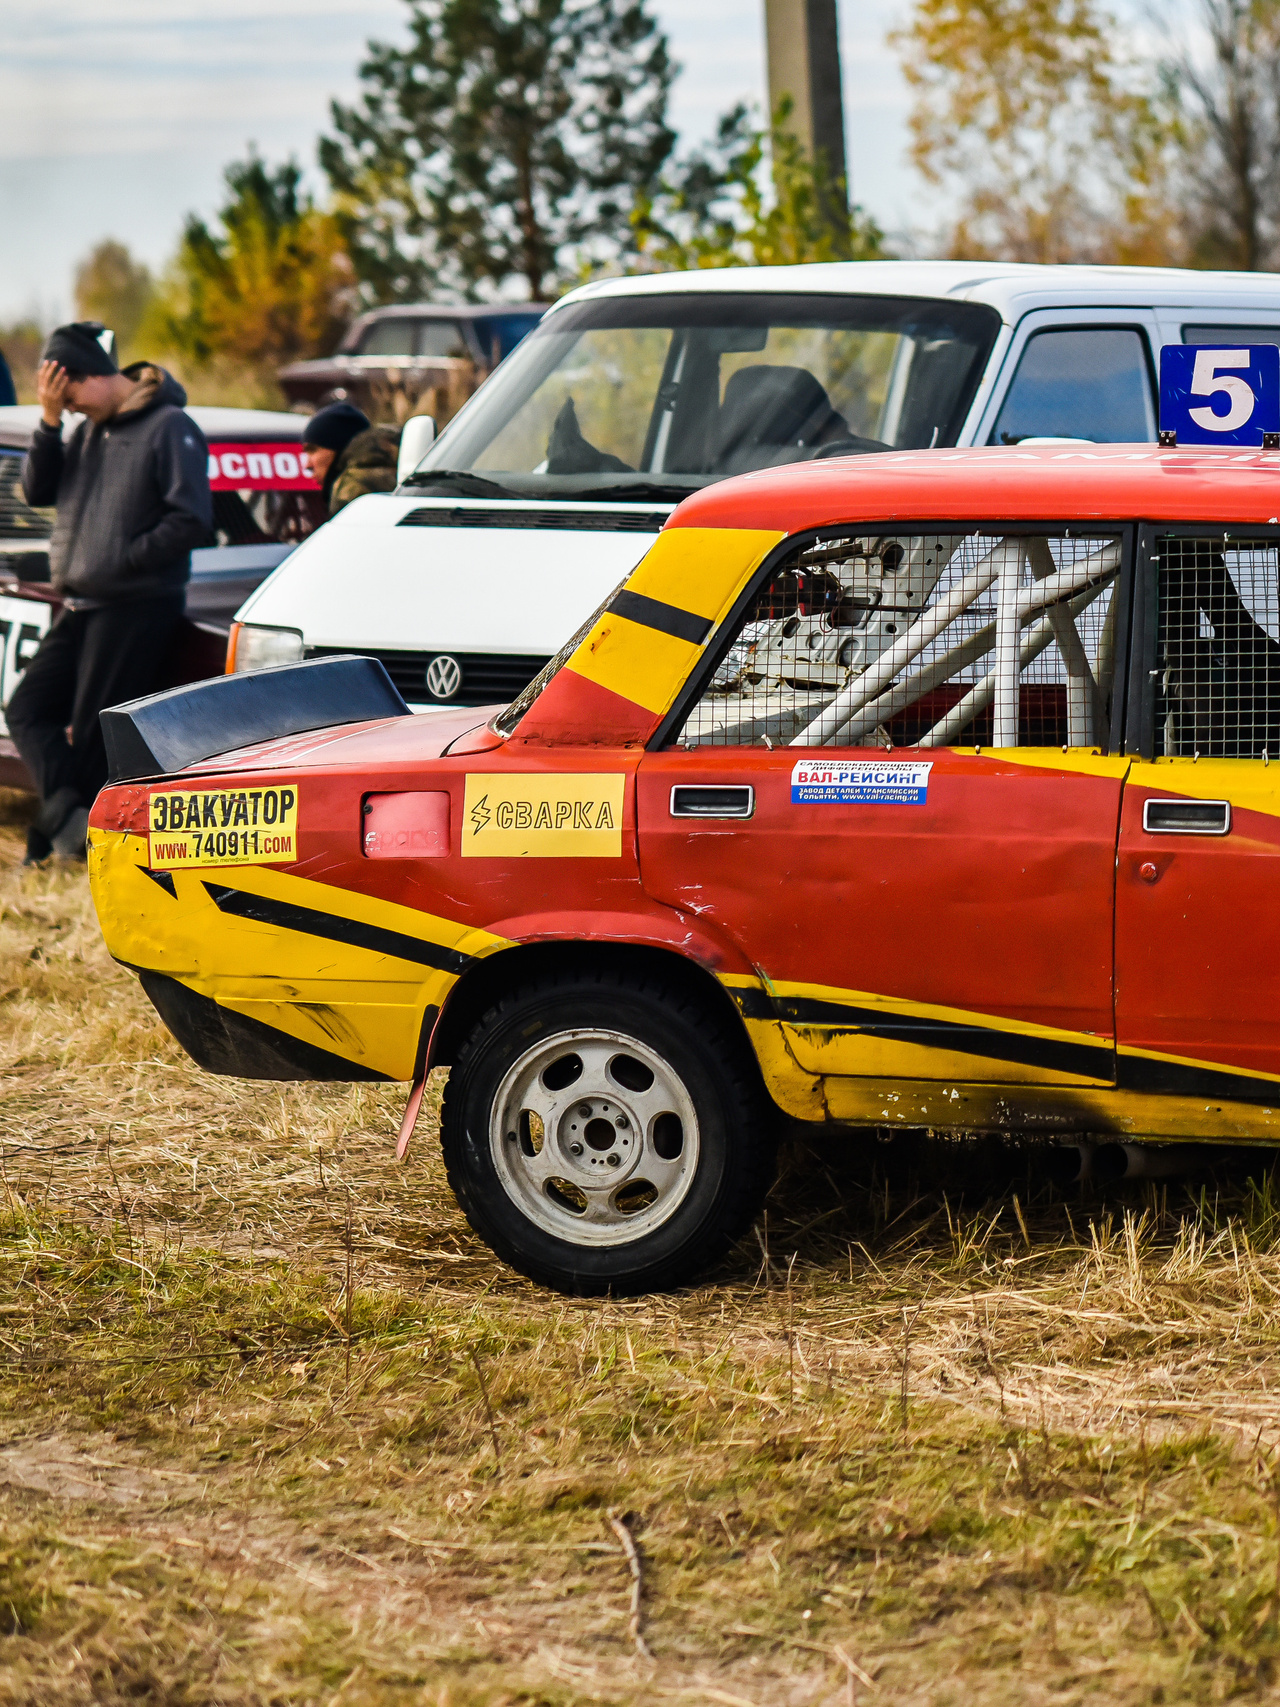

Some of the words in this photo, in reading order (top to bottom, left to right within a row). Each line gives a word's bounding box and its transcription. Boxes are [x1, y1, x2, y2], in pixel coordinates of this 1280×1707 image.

[1188, 348, 1255, 432] 5
[798, 771, 922, 784] ВАЛ-РЕЙСИНГ
[153, 789, 295, 831] ЭВАКУАТОР
[841, 793, 919, 802] www.val-racing.ru
[496, 801, 615, 830] СВАРКА
